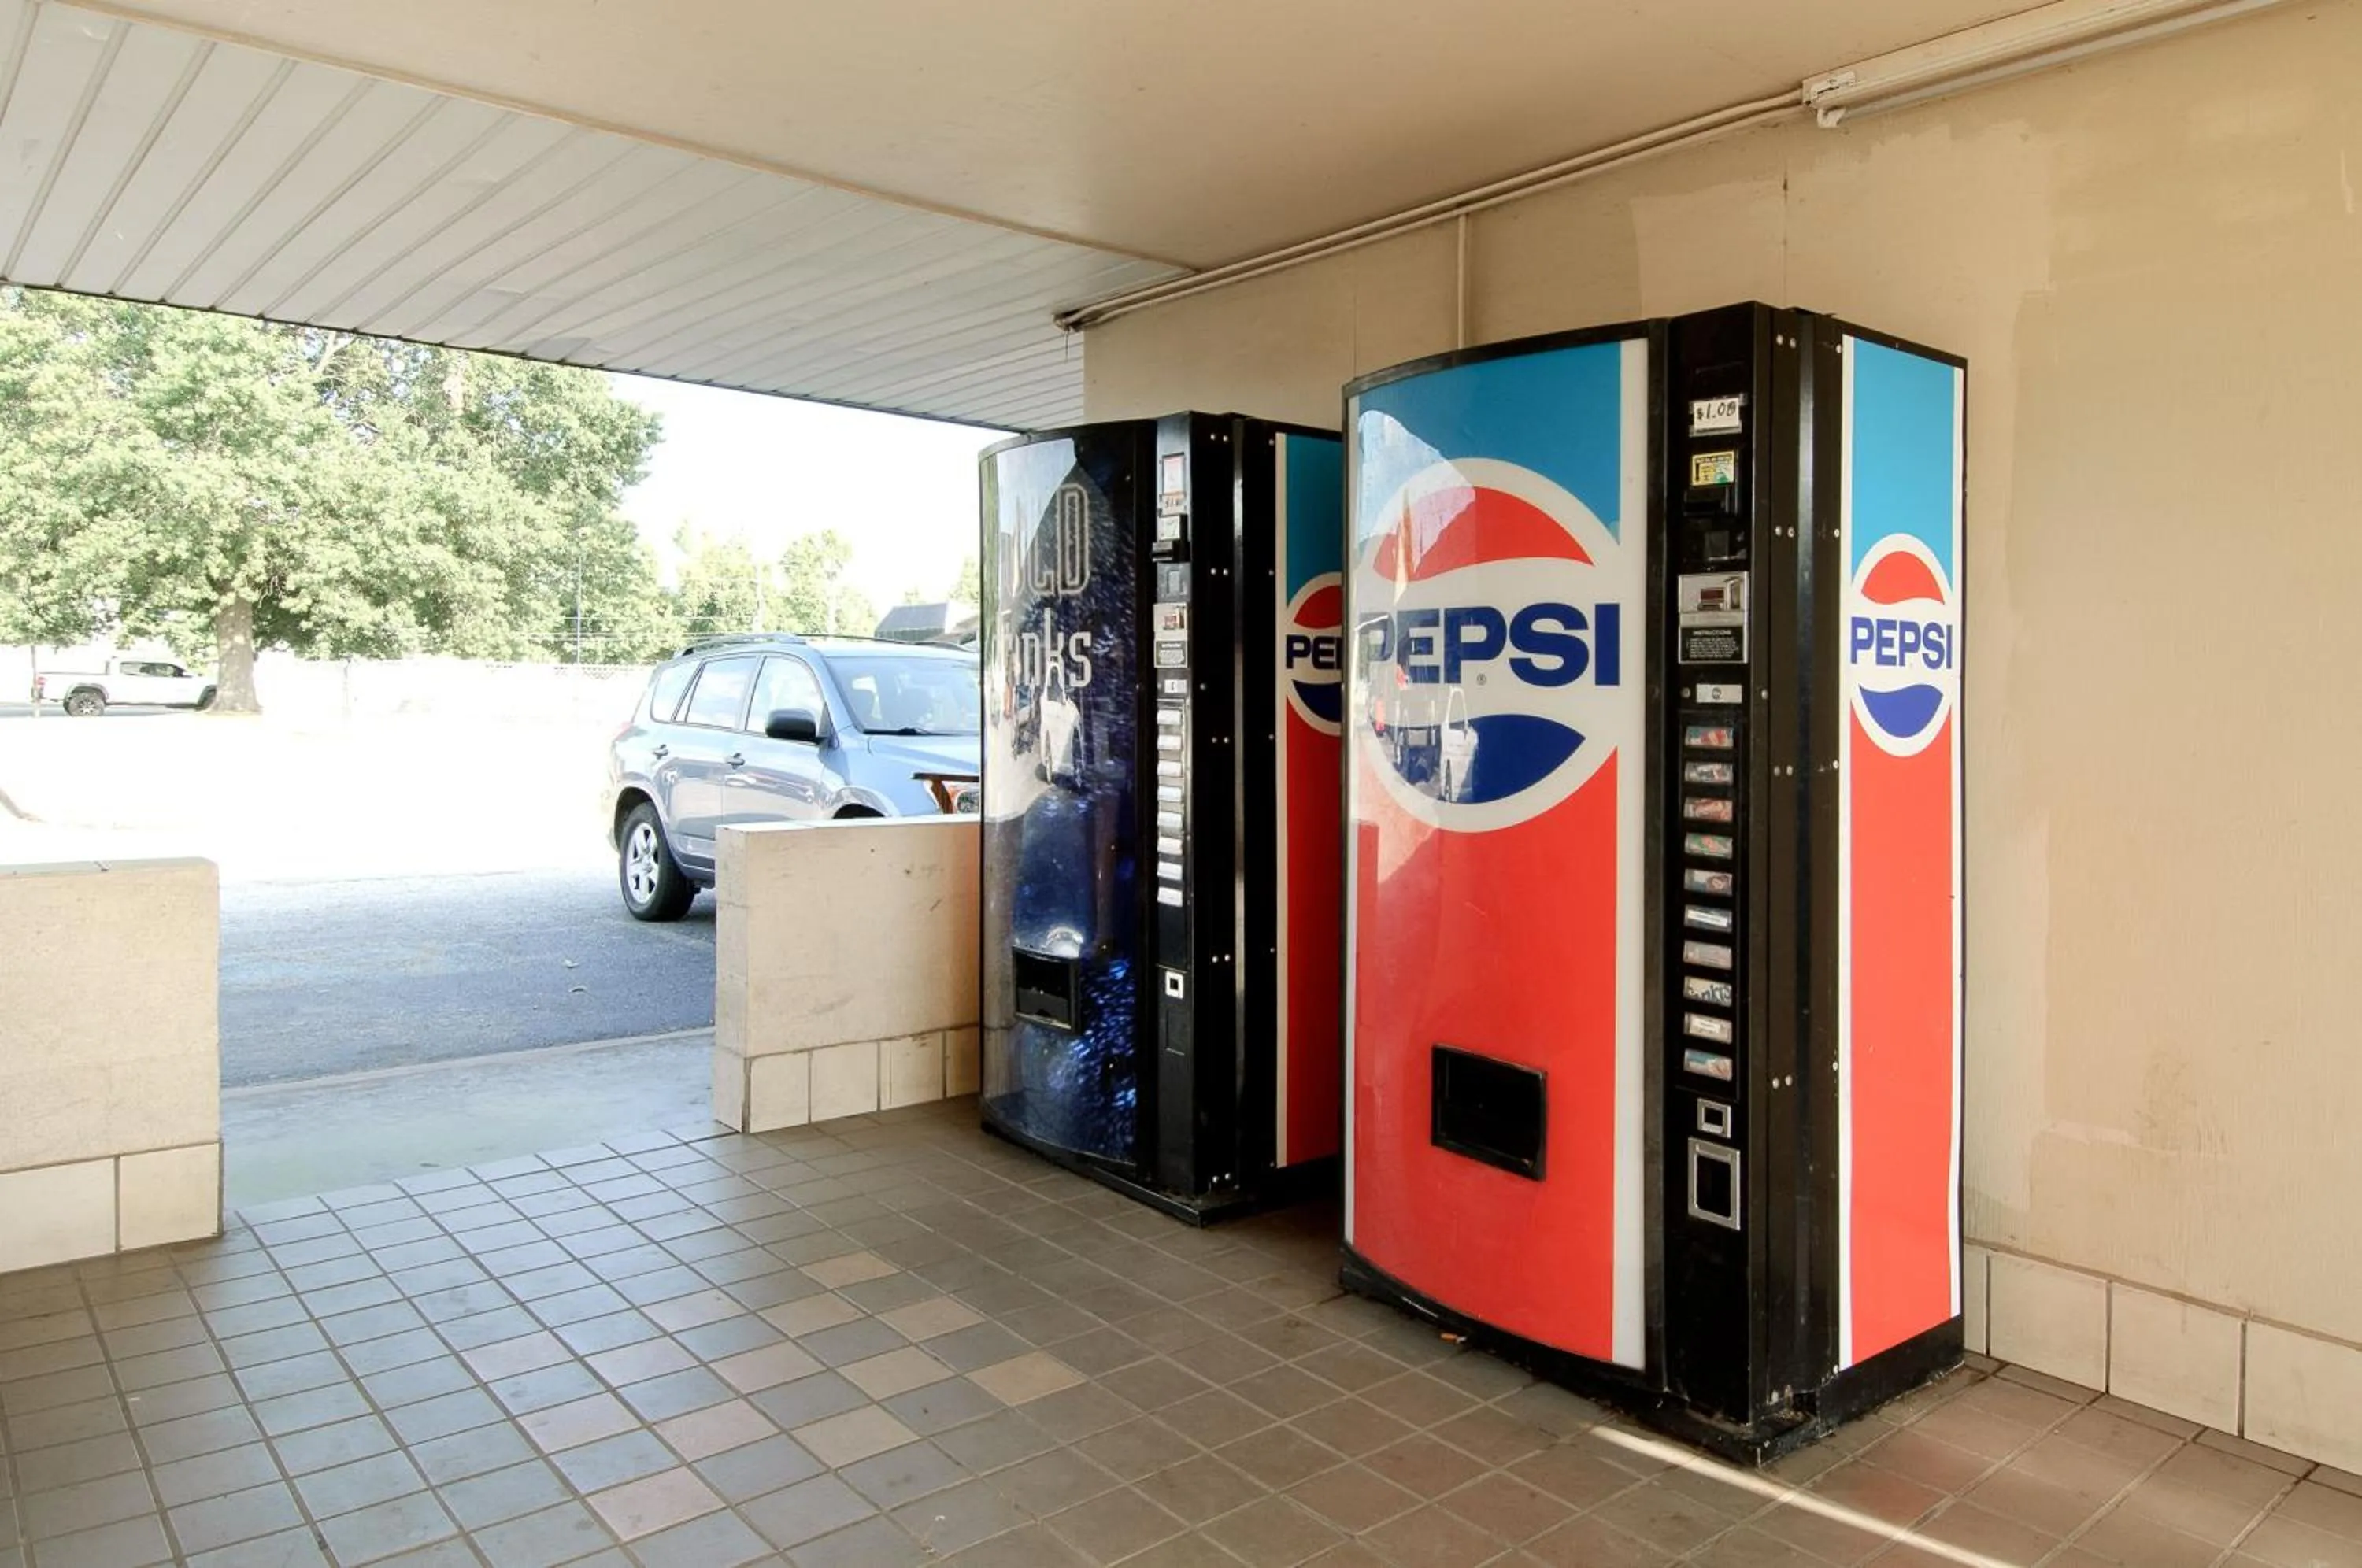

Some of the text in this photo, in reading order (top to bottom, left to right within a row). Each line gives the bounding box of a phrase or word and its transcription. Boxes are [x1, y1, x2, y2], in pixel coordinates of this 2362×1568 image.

[1286, 634, 1343, 669] PE
[1358, 601, 1620, 688] PEPSI
[1850, 616, 1953, 670] PEPSI
